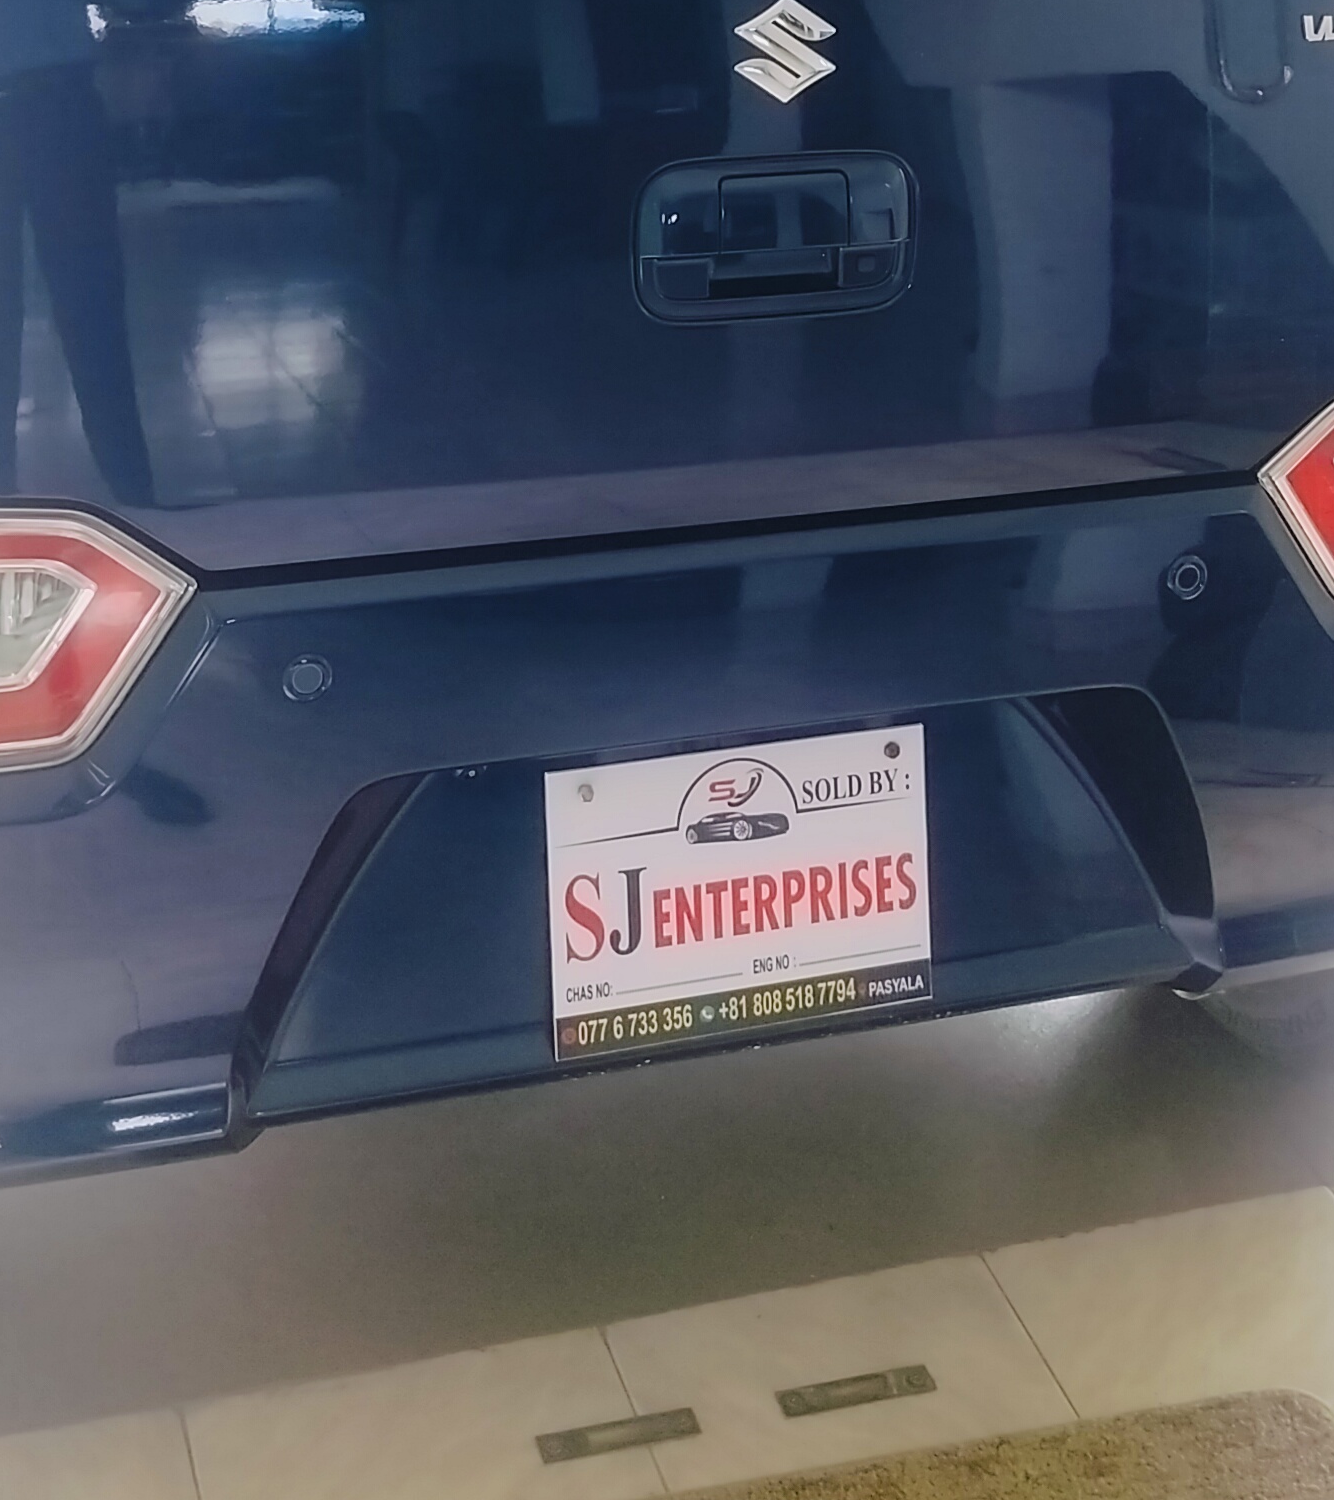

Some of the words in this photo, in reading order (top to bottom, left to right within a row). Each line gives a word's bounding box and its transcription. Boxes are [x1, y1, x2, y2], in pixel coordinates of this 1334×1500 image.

[801, 773, 863, 804] SOLD
[870, 769, 898, 796] BY
[564, 867, 647, 964] SJ
[653, 852, 917, 949] ENTERPRISES
[753, 956, 773, 974] ENG
[566, 984, 593, 1003] CHAS
[719, 995, 747, 1020] +81
[753, 989, 782, 1017] 808
[785, 984, 814, 1013] 518
[817, 977, 856, 1005] 7794
[868, 974, 924, 998] PASYALA
[578, 1018, 608, 1045] 077
[613, 1015, 624, 1040] 6
[628, 1010, 658, 1037] 733
[663, 1004, 693, 1031] 356
